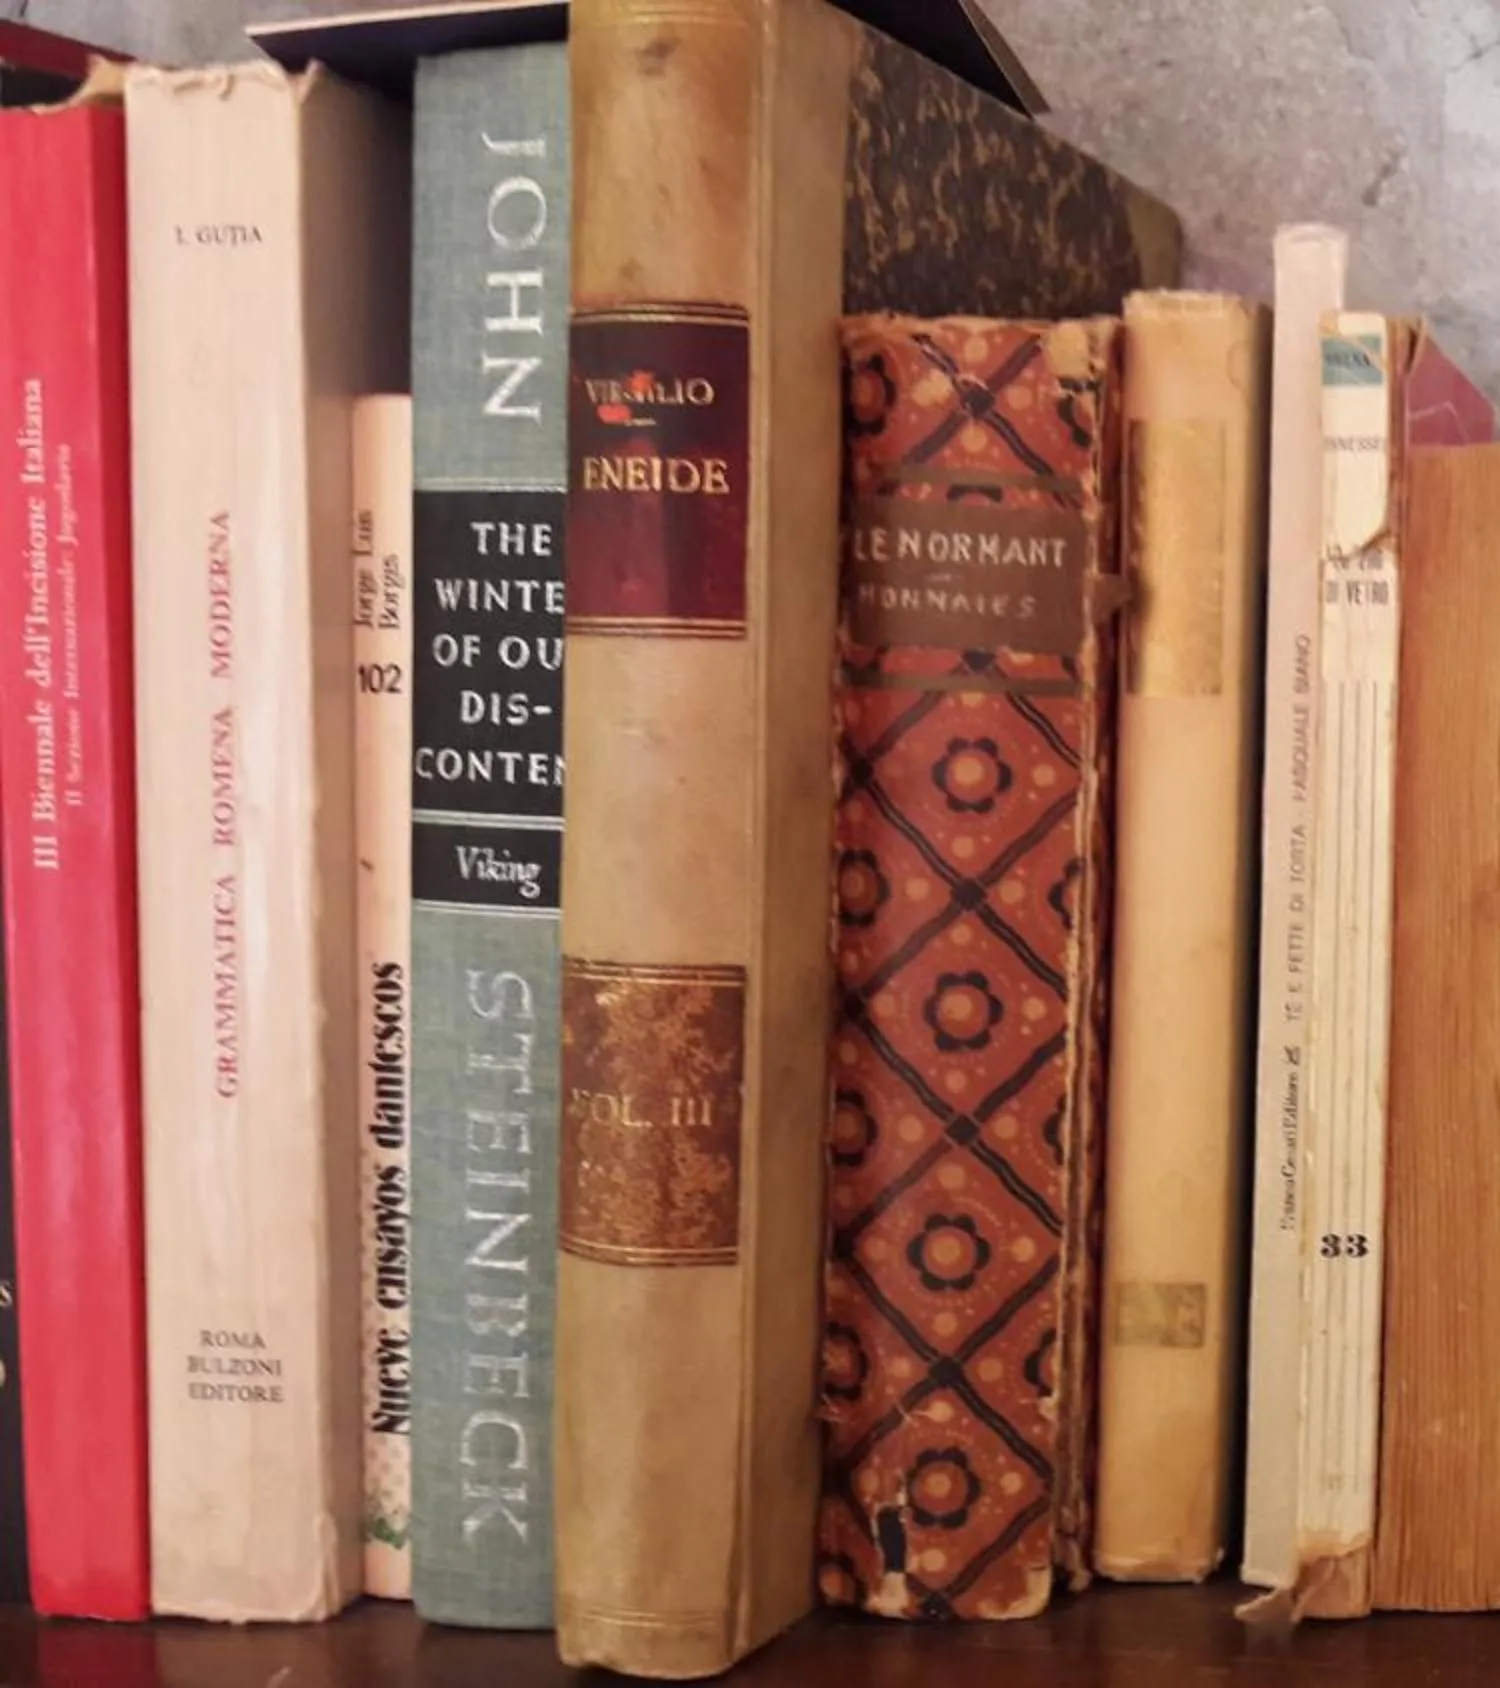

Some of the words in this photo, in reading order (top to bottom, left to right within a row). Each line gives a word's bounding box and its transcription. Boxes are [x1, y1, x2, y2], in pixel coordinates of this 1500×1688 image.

[480, 130, 548, 427] JOHN
[16, 377, 46, 486] Italiana
[582, 454, 731, 495] ENEIDE
[470, 521, 553, 557] THE
[207, 508, 233, 679] MODERNA
[433, 577, 566, 615] WINTE
[432, 633, 481, 669] OF
[498, 636, 566, 671] OU
[358, 663, 401, 694] 102
[460, 690, 553, 726] DIS-
[26, 700, 57, 823] Biennale
[211, 705, 236, 846] ROMENA
[33, 834, 59, 870] III
[455, 844, 541, 899] Viking
[213, 874, 240, 1099] GRAMMATICA
[368, 960, 406, 1150] dantescos
[670, 1095, 712, 1127] III
[374, 1162, 412, 1310] ensayos
[459, 967, 536, 1545] STEINBECK
[1321, 1234, 1369, 1258] 33
[199, 1329, 267, 1349] ROMA
[186, 1355, 284, 1378] BULZONI
[366, 1328, 412, 1436] Nueve
[187, 1382, 284, 1404] EDITORE
